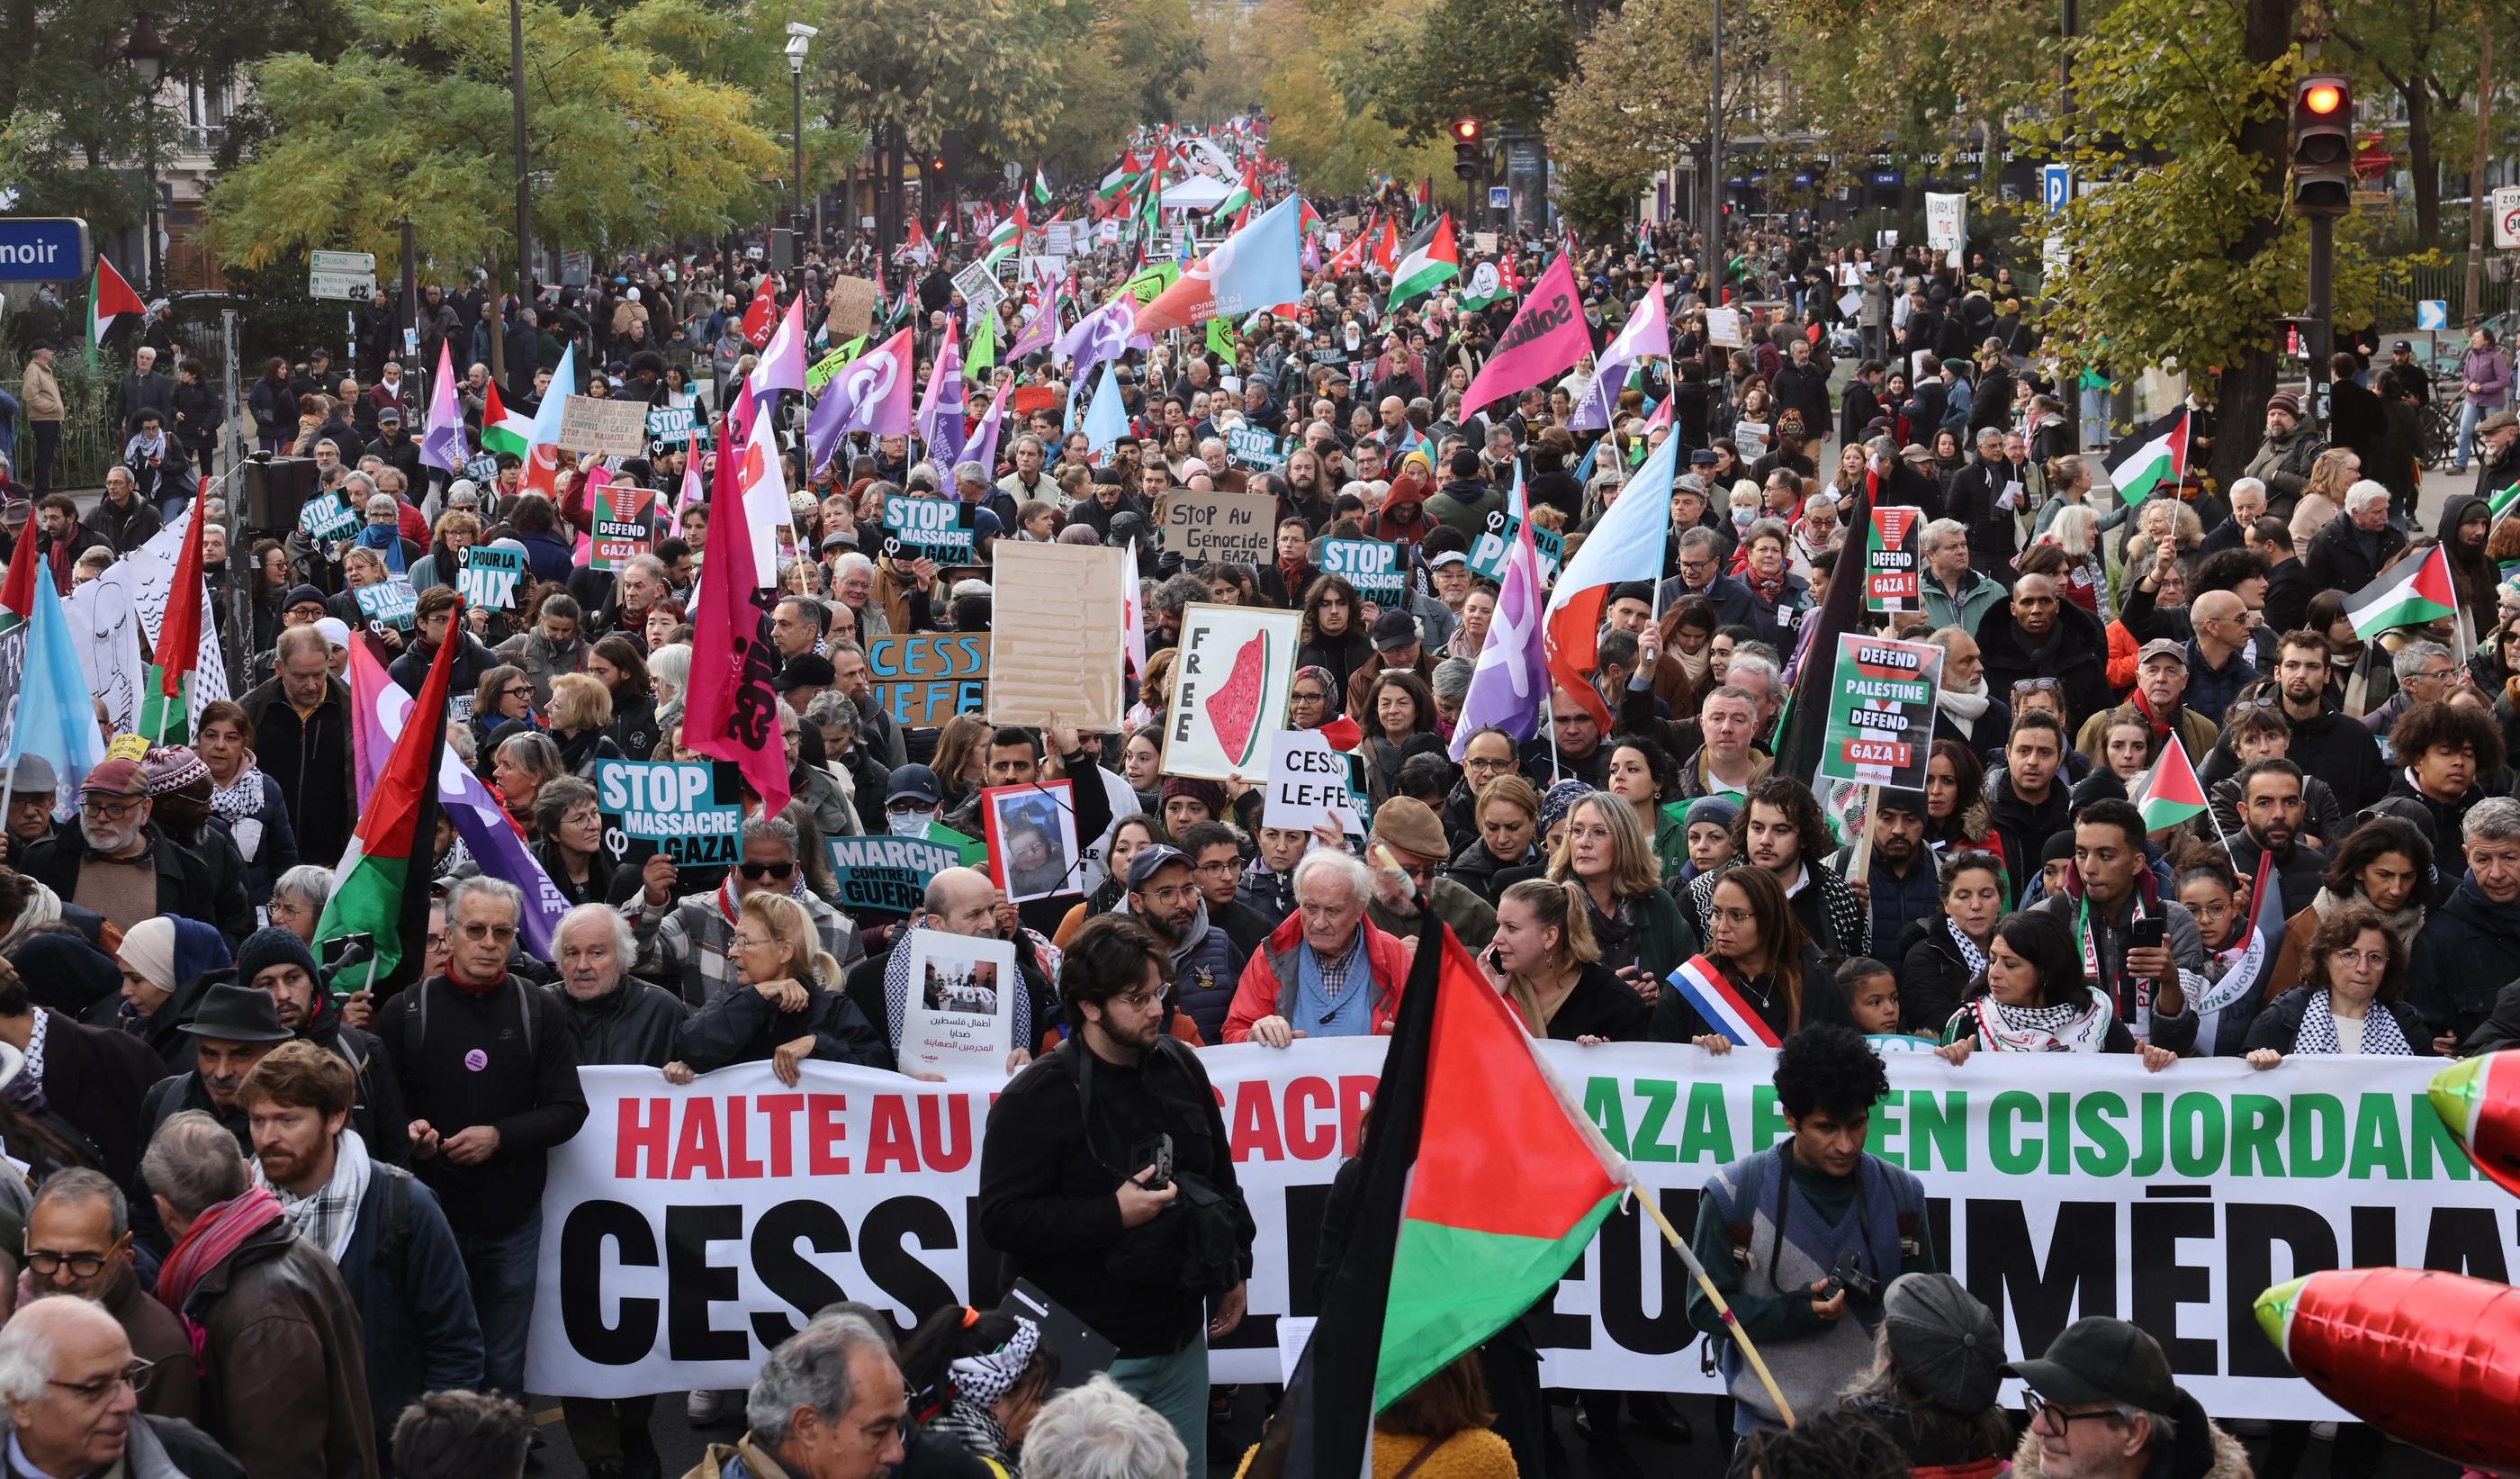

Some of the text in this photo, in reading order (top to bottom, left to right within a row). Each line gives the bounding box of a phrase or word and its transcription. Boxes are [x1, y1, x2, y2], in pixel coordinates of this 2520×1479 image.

[2050, 177, 2062, 212] P
[0, 238, 58, 264] noir
[562, 428, 580, 437] STOP
[650, 410, 694, 433] STOP
[1229, 428, 1274, 451] STOP
[467, 457, 497, 477] STO
[1237, 448, 1281, 464] MASSACRE
[301, 495, 338, 530] STOP
[312, 510, 356, 537] MASSACRE
[886, 498, 957, 530] STOP
[329, 522, 360, 542] GAZA
[599, 521, 646, 537] DEFEND
[900, 528, 971, 546] MASSACRE
[1187, 528, 1268, 549] Génocide
[472, 551, 516, 569] POUR LA
[600, 545, 634, 555] GAZA
[924, 545, 969, 564] GAZA
[1221, 549, 1259, 564] GAZA
[1325, 541, 1394, 573] STOP
[1872, 552, 1912, 567] DEFEND
[458, 567, 518, 609] PAIX
[1874, 578, 1904, 593] GAZA
[869, 637, 984, 677] CESS
[1859, 647, 1918, 669] DEFEND
[1175, 627, 1210, 743] FREE
[1846, 679, 1923, 700] PALESTINE
[1851, 709, 1909, 731] DEFEND
[1286, 750, 1343, 776] CESS
[1850, 743, 1894, 762] GAZA
[602, 762, 708, 812] STOP
[1281, 782, 1354, 809] LE-FE
[625, 810, 738, 835] MASSACRE
[664, 834, 739, 865] GAZA
[850, 868, 919, 885] CONTRE LA
[615, 1094, 850, 1180] HALTE
[865, 1093, 973, 1174] AU
[1581, 1075, 1734, 1164] AZA
